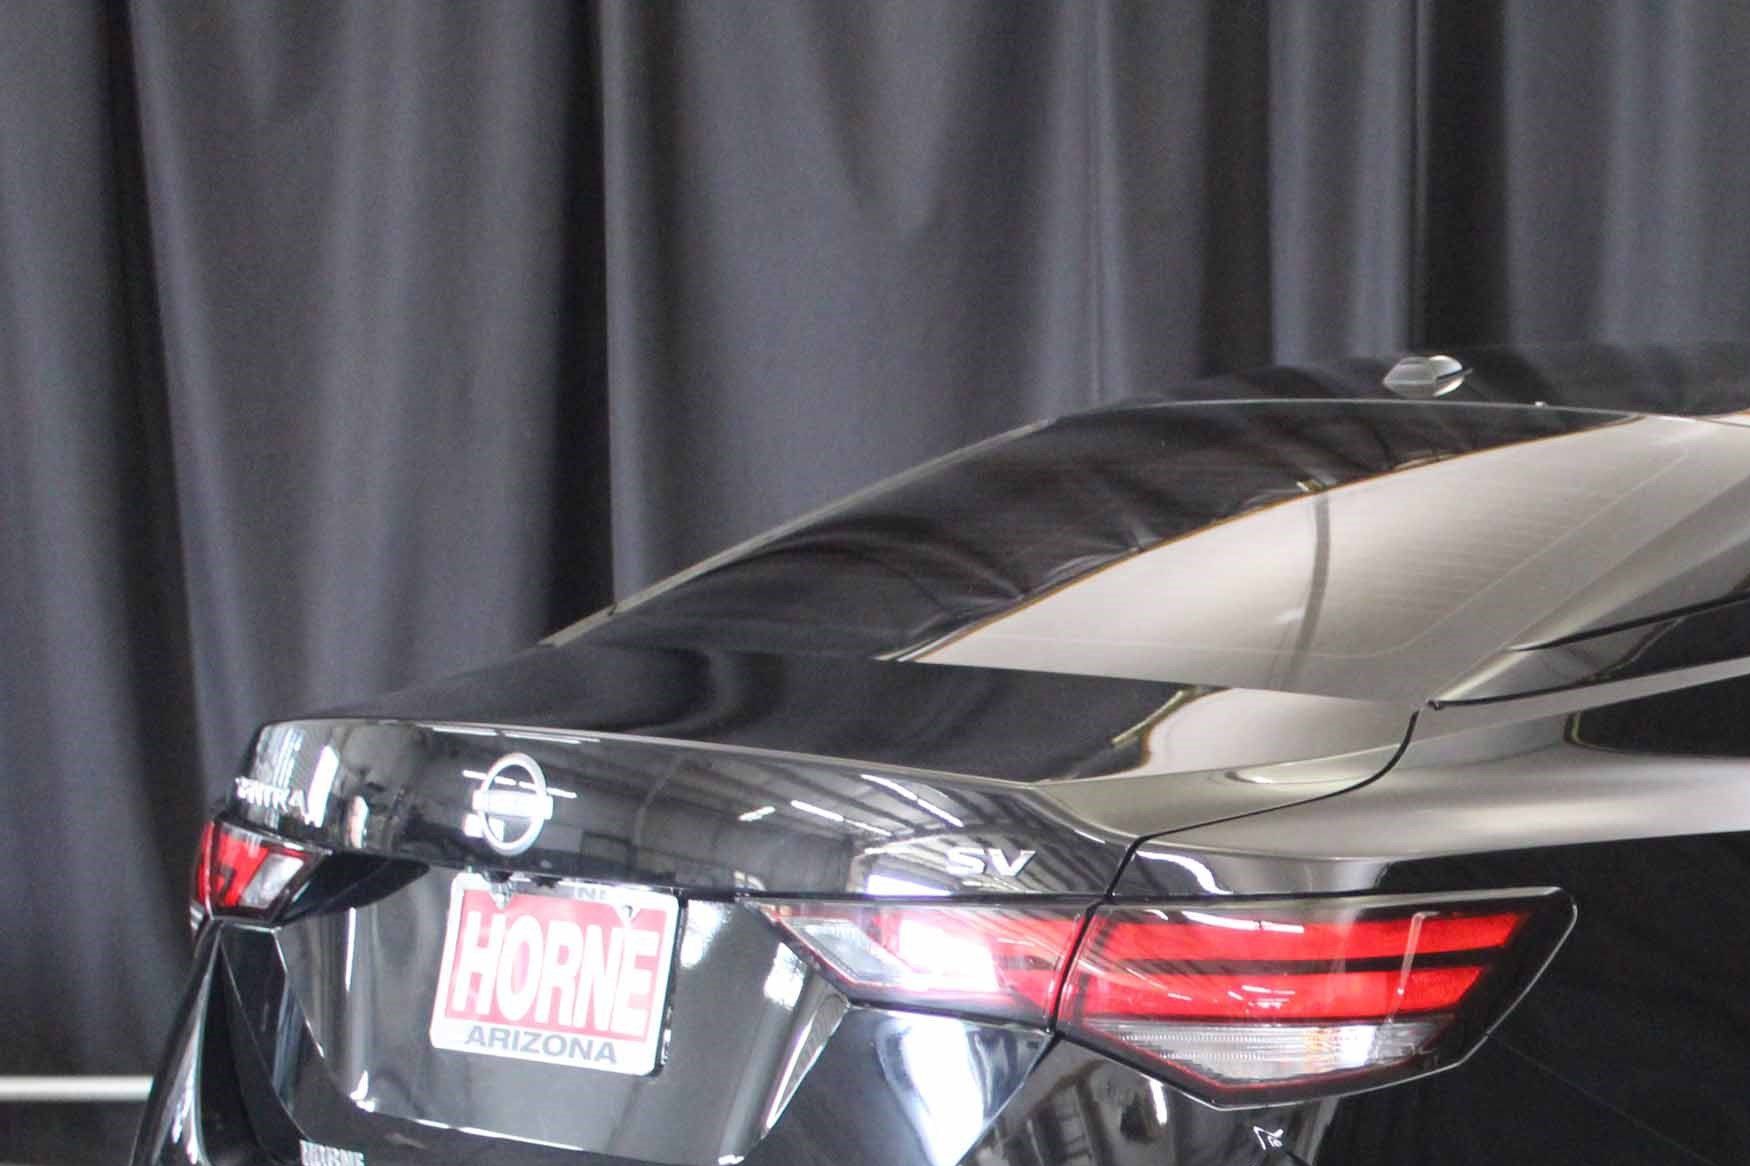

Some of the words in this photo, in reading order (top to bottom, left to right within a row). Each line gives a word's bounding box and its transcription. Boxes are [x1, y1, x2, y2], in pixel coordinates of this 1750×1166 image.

[944, 846, 1037, 877] SV
[451, 910, 661, 1036] HORNE
[464, 1024, 617, 1065] ARIZONA
